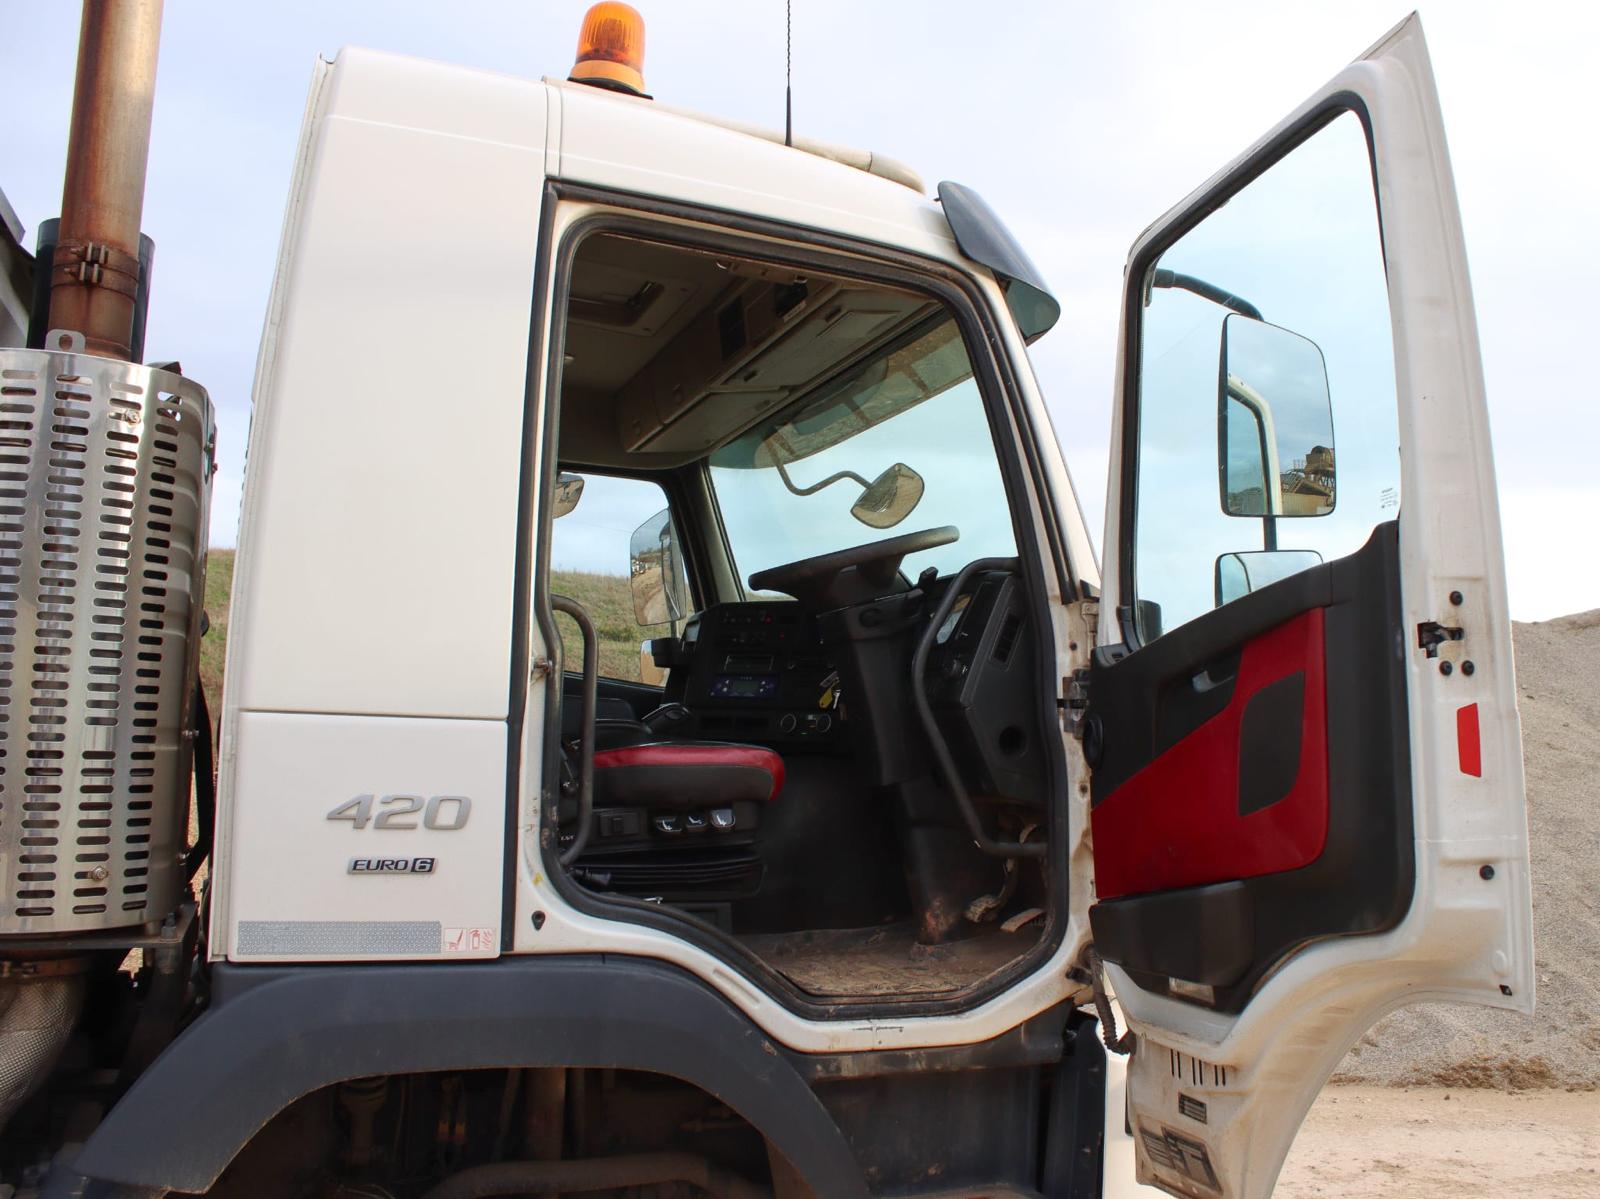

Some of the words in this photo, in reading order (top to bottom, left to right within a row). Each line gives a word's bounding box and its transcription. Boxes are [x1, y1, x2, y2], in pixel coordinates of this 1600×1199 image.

[326, 794, 472, 830] 420
[351, 859, 409, 871] EURO
[411, 858, 434, 873] 6
